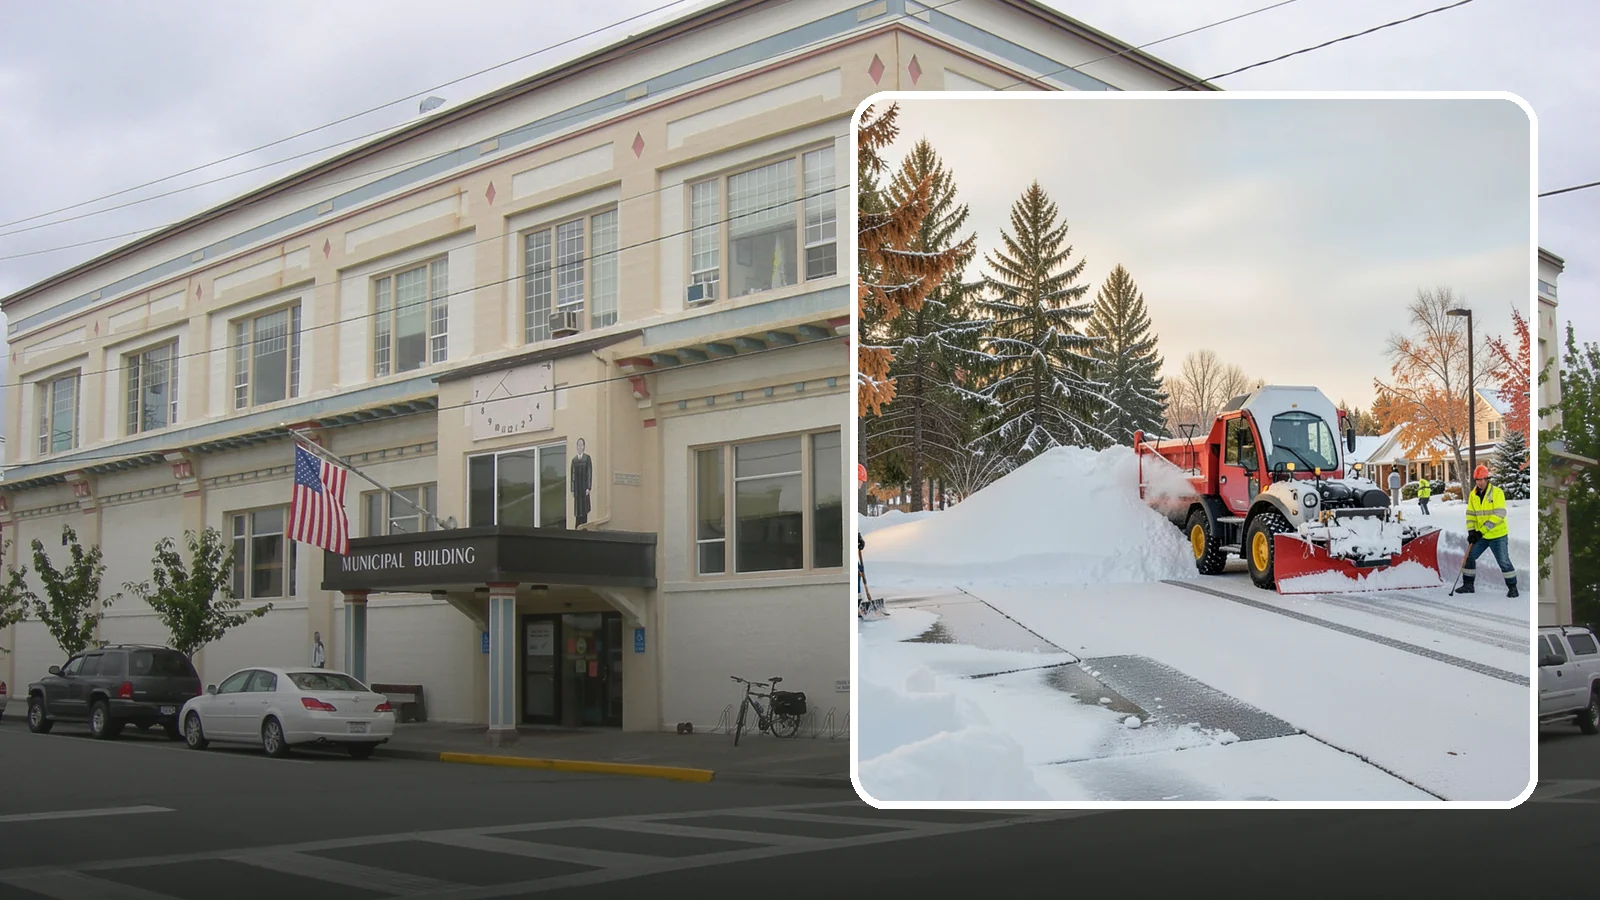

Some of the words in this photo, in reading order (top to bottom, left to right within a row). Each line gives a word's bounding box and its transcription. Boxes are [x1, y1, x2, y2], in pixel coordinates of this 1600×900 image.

[536, 402, 540, 410] 4
[480, 407, 485, 415] 8
[487, 417, 492, 425] 9
[529, 414, 533, 422] 3
[521, 420, 525, 428] 2
[507, 425, 513, 433] 12
[342, 552, 405, 572] MUNICIPAL
[414, 546, 475, 567] BUILDING
